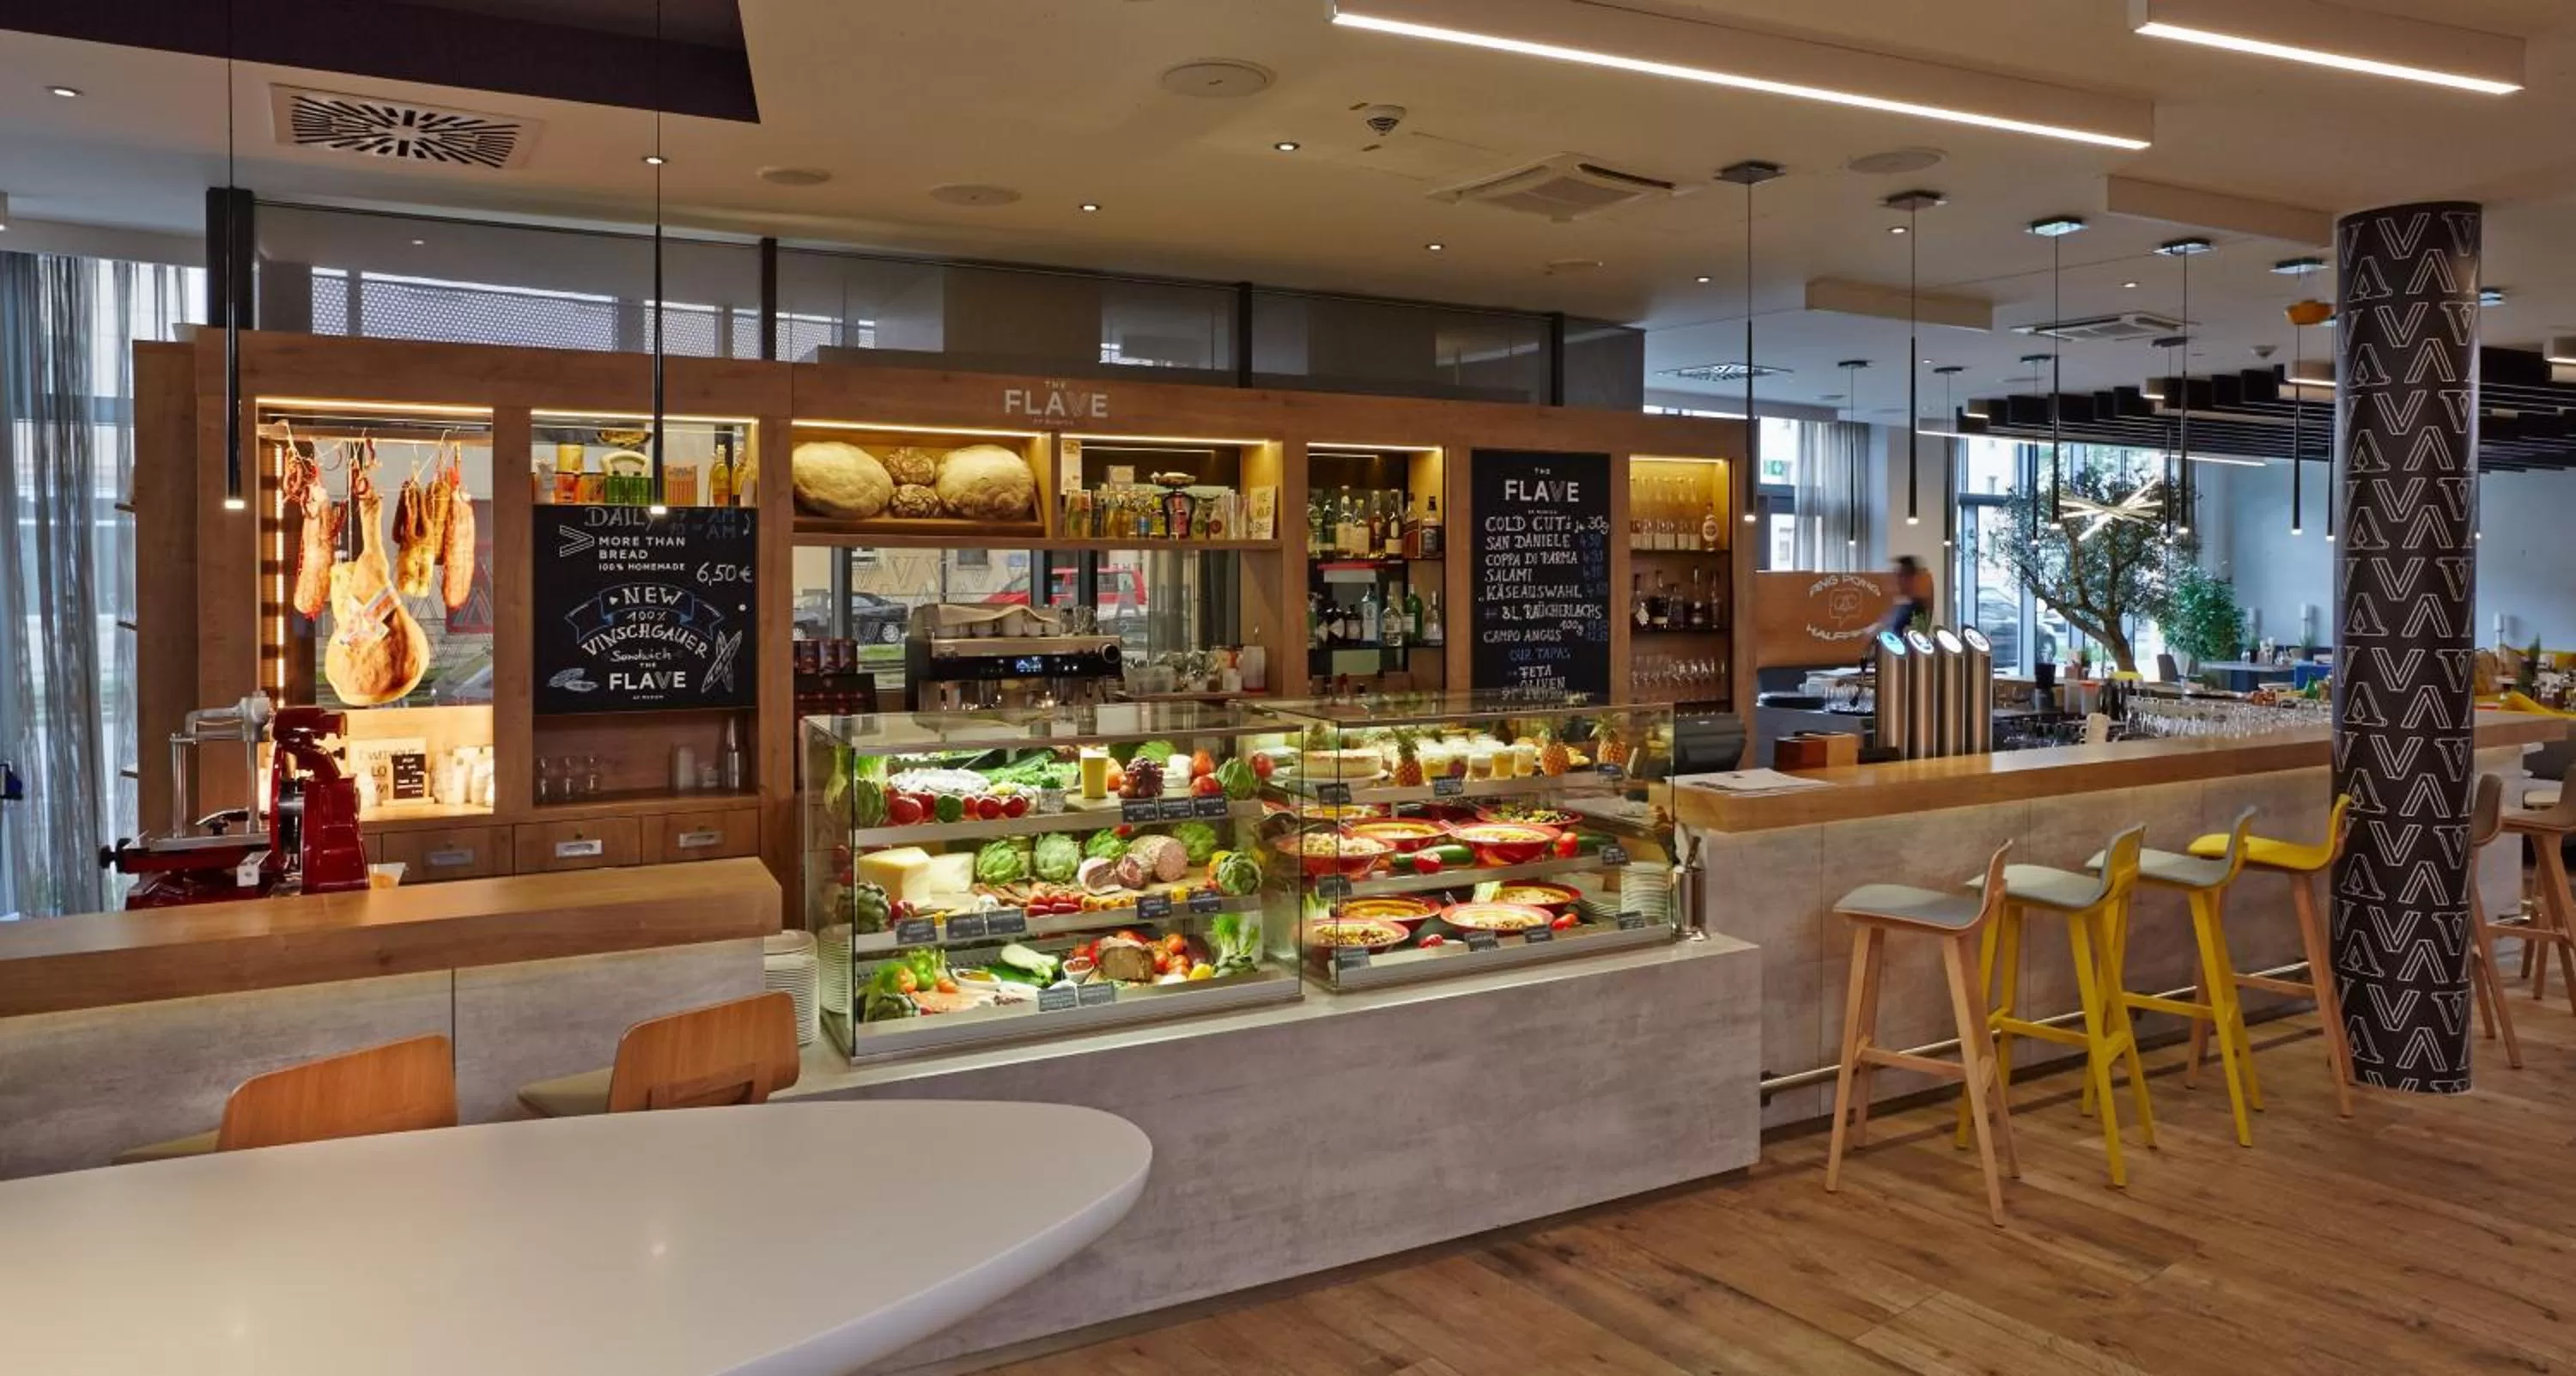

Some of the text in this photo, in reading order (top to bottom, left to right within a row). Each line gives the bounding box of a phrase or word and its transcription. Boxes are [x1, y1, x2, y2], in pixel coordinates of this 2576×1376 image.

[1005, 389, 1109, 418] FLAVE
[1504, 478, 1580, 503] FLAVE
[1485, 515, 1527, 532] COLD
[598, 535, 686, 547] MORE THAN
[1485, 534, 1510, 551] SAN
[1514, 533, 1571, 549] DANIELE
[598, 549, 648, 560] BREAD
[1485, 552, 1521, 568] COPPA
[1539, 551, 1578, 565] PARMA
[598, 562, 686, 572] 100% HOMEMADE
[1485, 568, 1533, 583] SALAMI
[622, 586, 683, 606] NEW
[627, 610, 667, 622] 100%
[580, 623, 709, 660] VINSCHGAUER
[1483, 629, 1521, 643] CAMPO
[1523, 628, 1562, 642] ANGUS
[610, 647, 672, 662] Sandwich
[1518, 664, 1552, 679] FETA
[609, 670, 687, 691] FLAVE
